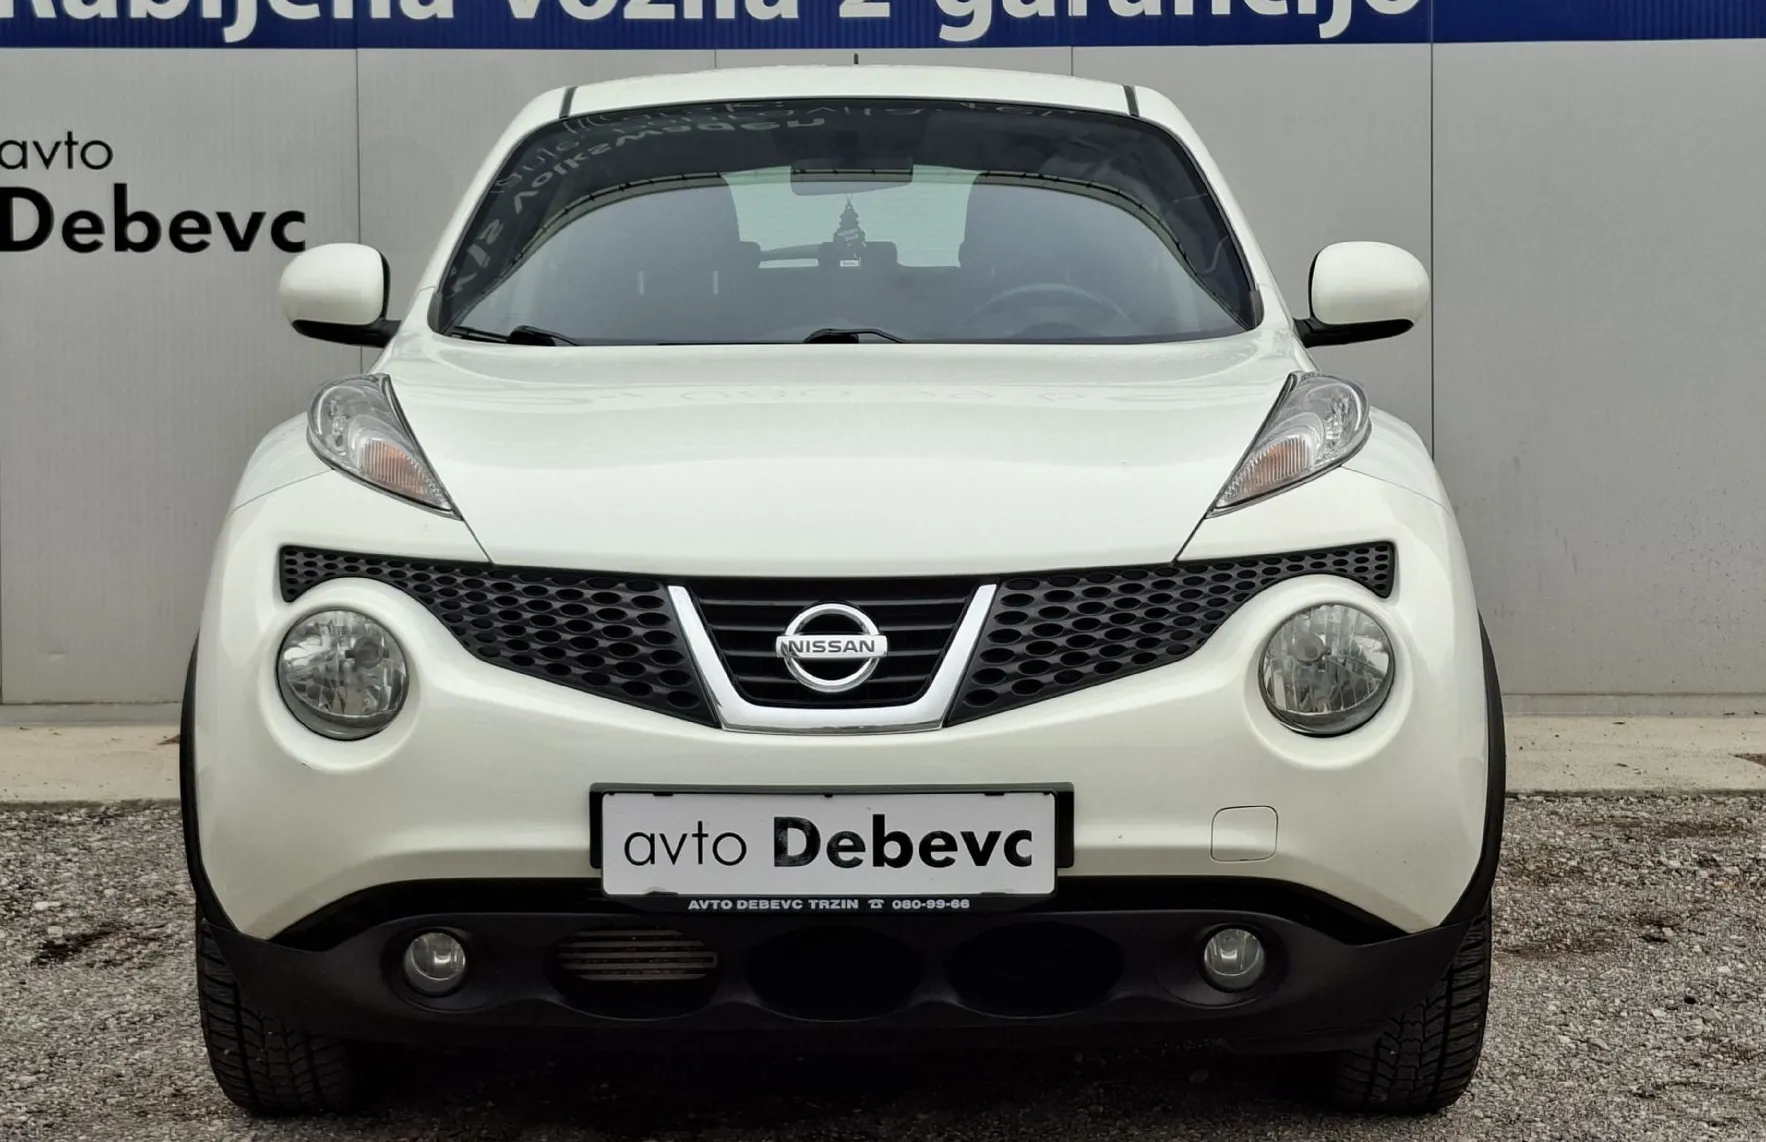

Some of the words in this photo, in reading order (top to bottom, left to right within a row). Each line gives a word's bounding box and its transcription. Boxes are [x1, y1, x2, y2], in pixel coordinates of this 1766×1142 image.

[0, 131, 114, 170] avto
[0, 182, 306, 254] Debevc
[787, 639, 875, 654] NISSAN
[623, 820, 747, 867] avto
[773, 813, 1033, 869] Debevc
[688, 899, 733, 910] AVTO
[736, 899, 803, 910] DEBEVC
[808, 899, 859, 910] TRZIN
[891, 898, 970, 909] 080-99-66
